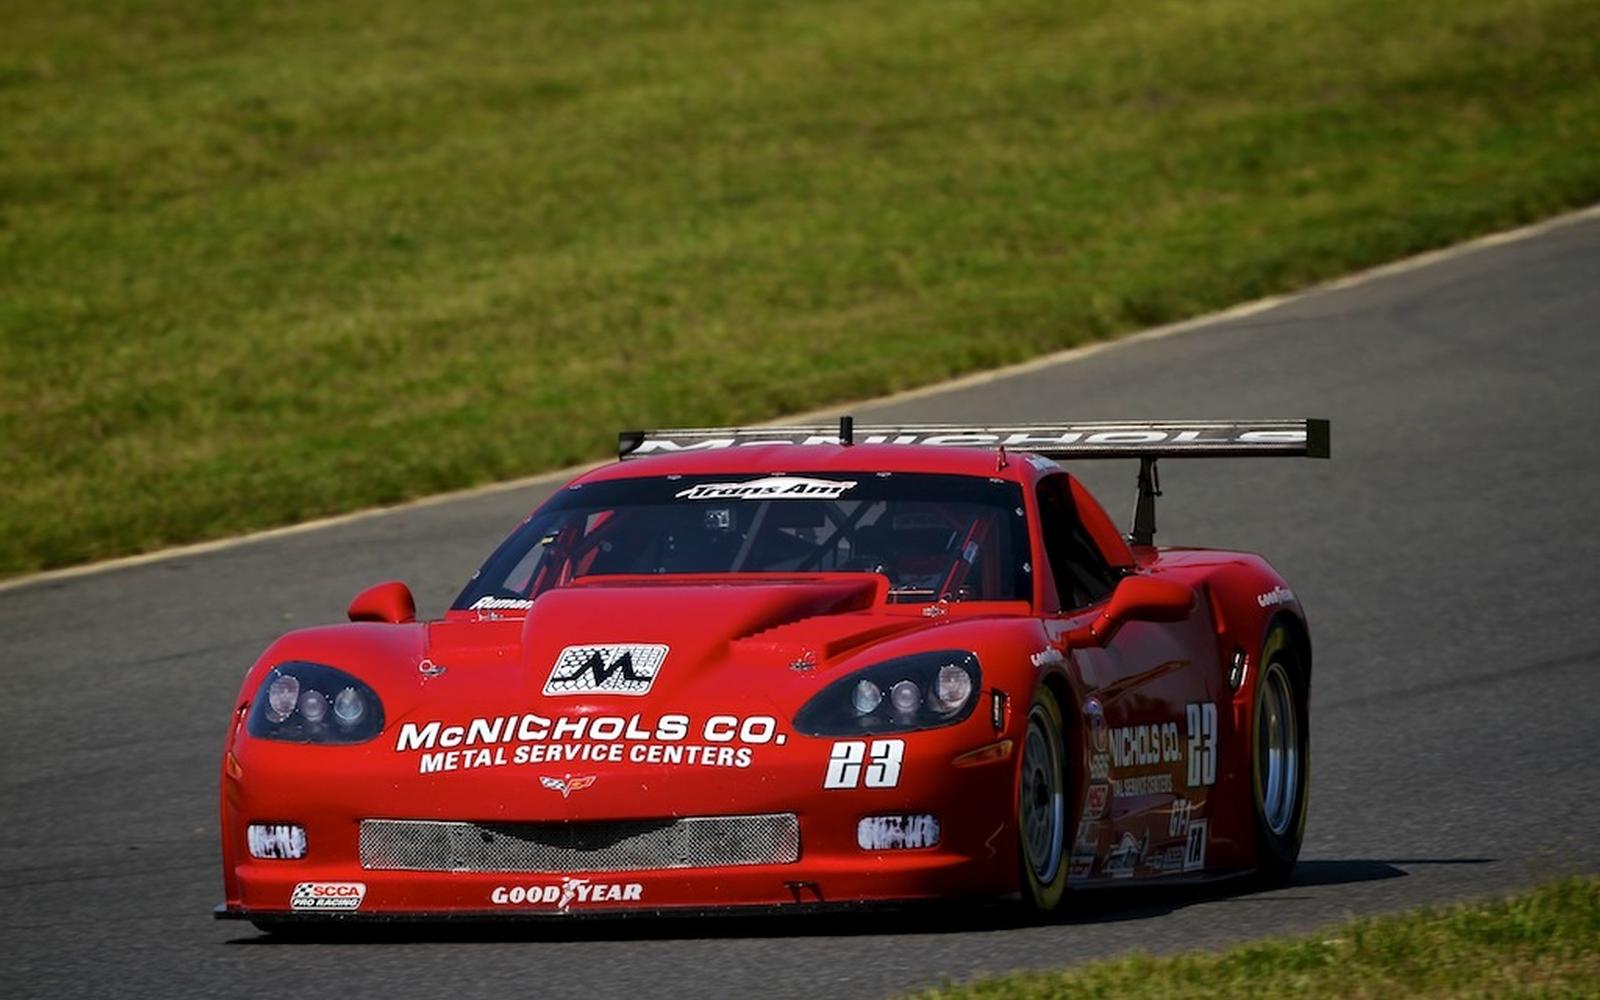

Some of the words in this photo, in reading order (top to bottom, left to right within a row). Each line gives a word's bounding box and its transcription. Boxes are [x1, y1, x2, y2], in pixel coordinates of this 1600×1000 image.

[692, 484, 780, 498] Trans
[780, 482, 846, 497] Am
[396, 714, 689, 751] McNICHOLS
[703, 714, 788, 746] CO.
[1186, 702, 1218, 787] 23
[419, 746, 508, 774] METAL
[513, 743, 622, 764] SERVICE
[627, 745, 753, 768] CENTERS
[824, 739, 905, 789] 23
[293, 898, 315, 906] PRO
[316, 898, 358, 906] RACING
[313, 886, 359, 896] SCCA
